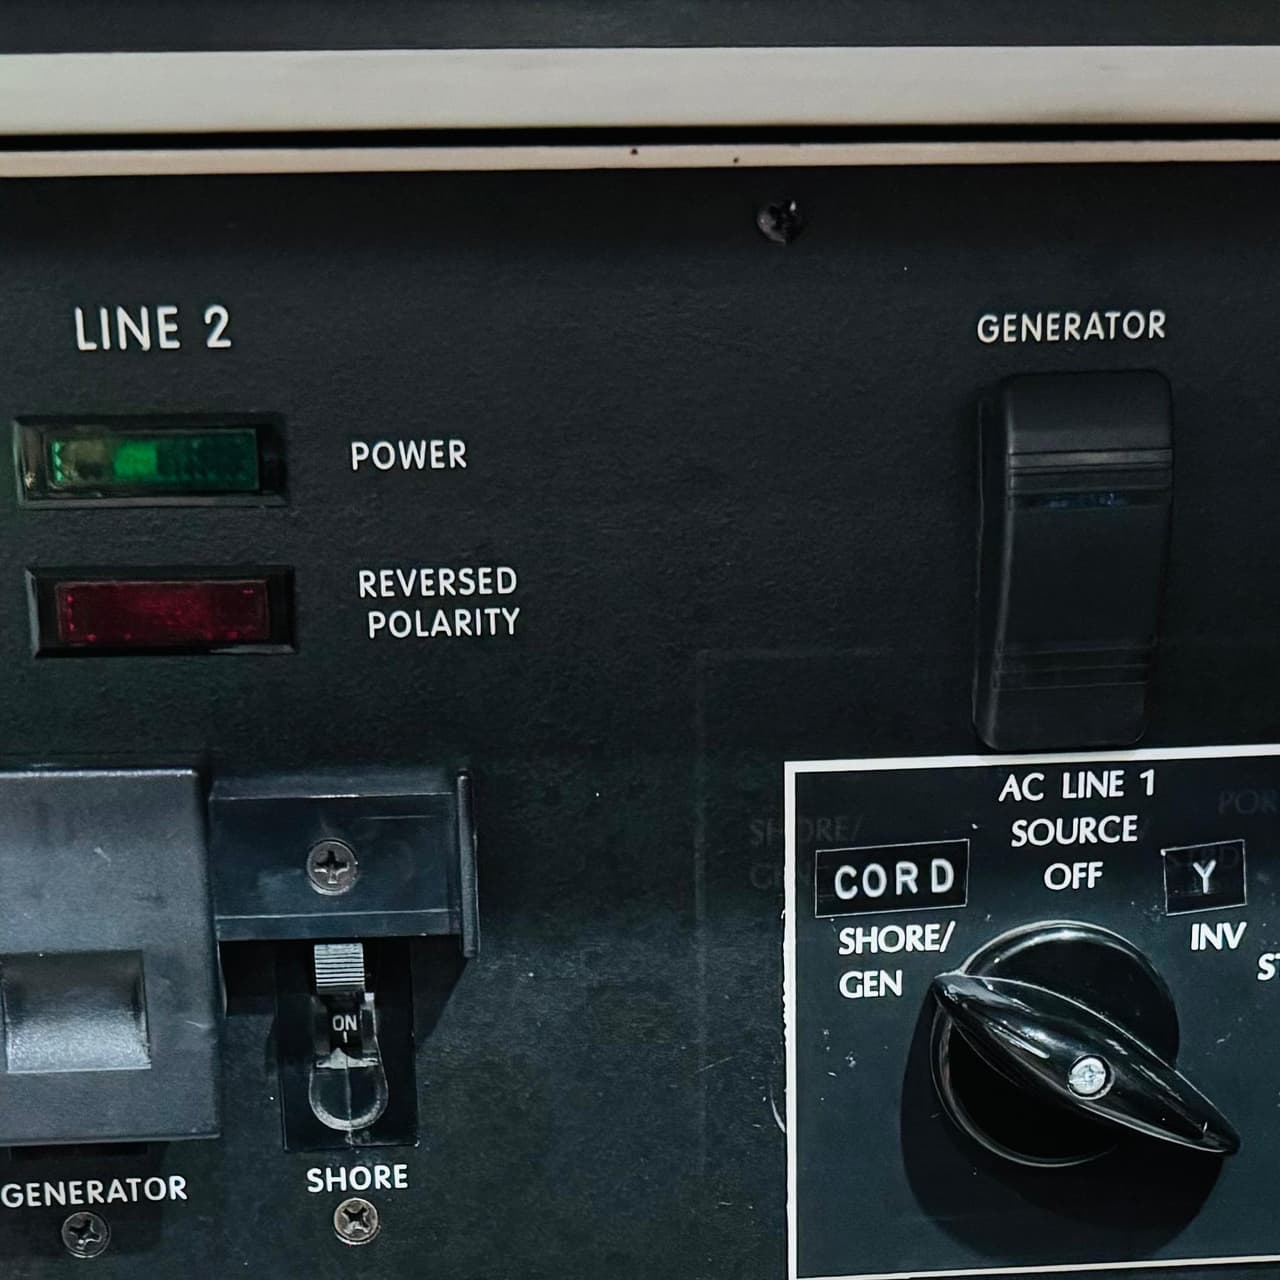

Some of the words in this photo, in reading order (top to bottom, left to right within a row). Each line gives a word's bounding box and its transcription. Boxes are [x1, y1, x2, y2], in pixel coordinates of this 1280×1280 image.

[75, 306, 180, 350] LINE
[205, 305, 231, 348] 2
[977, 311, 1167, 343] GENERATOR
[351, 440, 467, 470] POWER
[359, 567, 517, 597] REVERSED
[368, 608, 520, 639] POLARITY
[999, 774, 1044, 802] AC
[1063, 771, 1123, 800] LINE
[1140, 769, 1155, 796] 1
[1011, 816, 1138, 847] SOURCE
[1045, 862, 1103, 891] OFF
[838, 922, 956, 955] SHORE/
[1191, 922, 1247, 951] INV
[839, 970, 902, 998] GEN
[333, 1015, 357, 1032] ON
[1, 1176, 187, 1209] GENERATOR
[306, 1164, 409, 1194] SHORE
